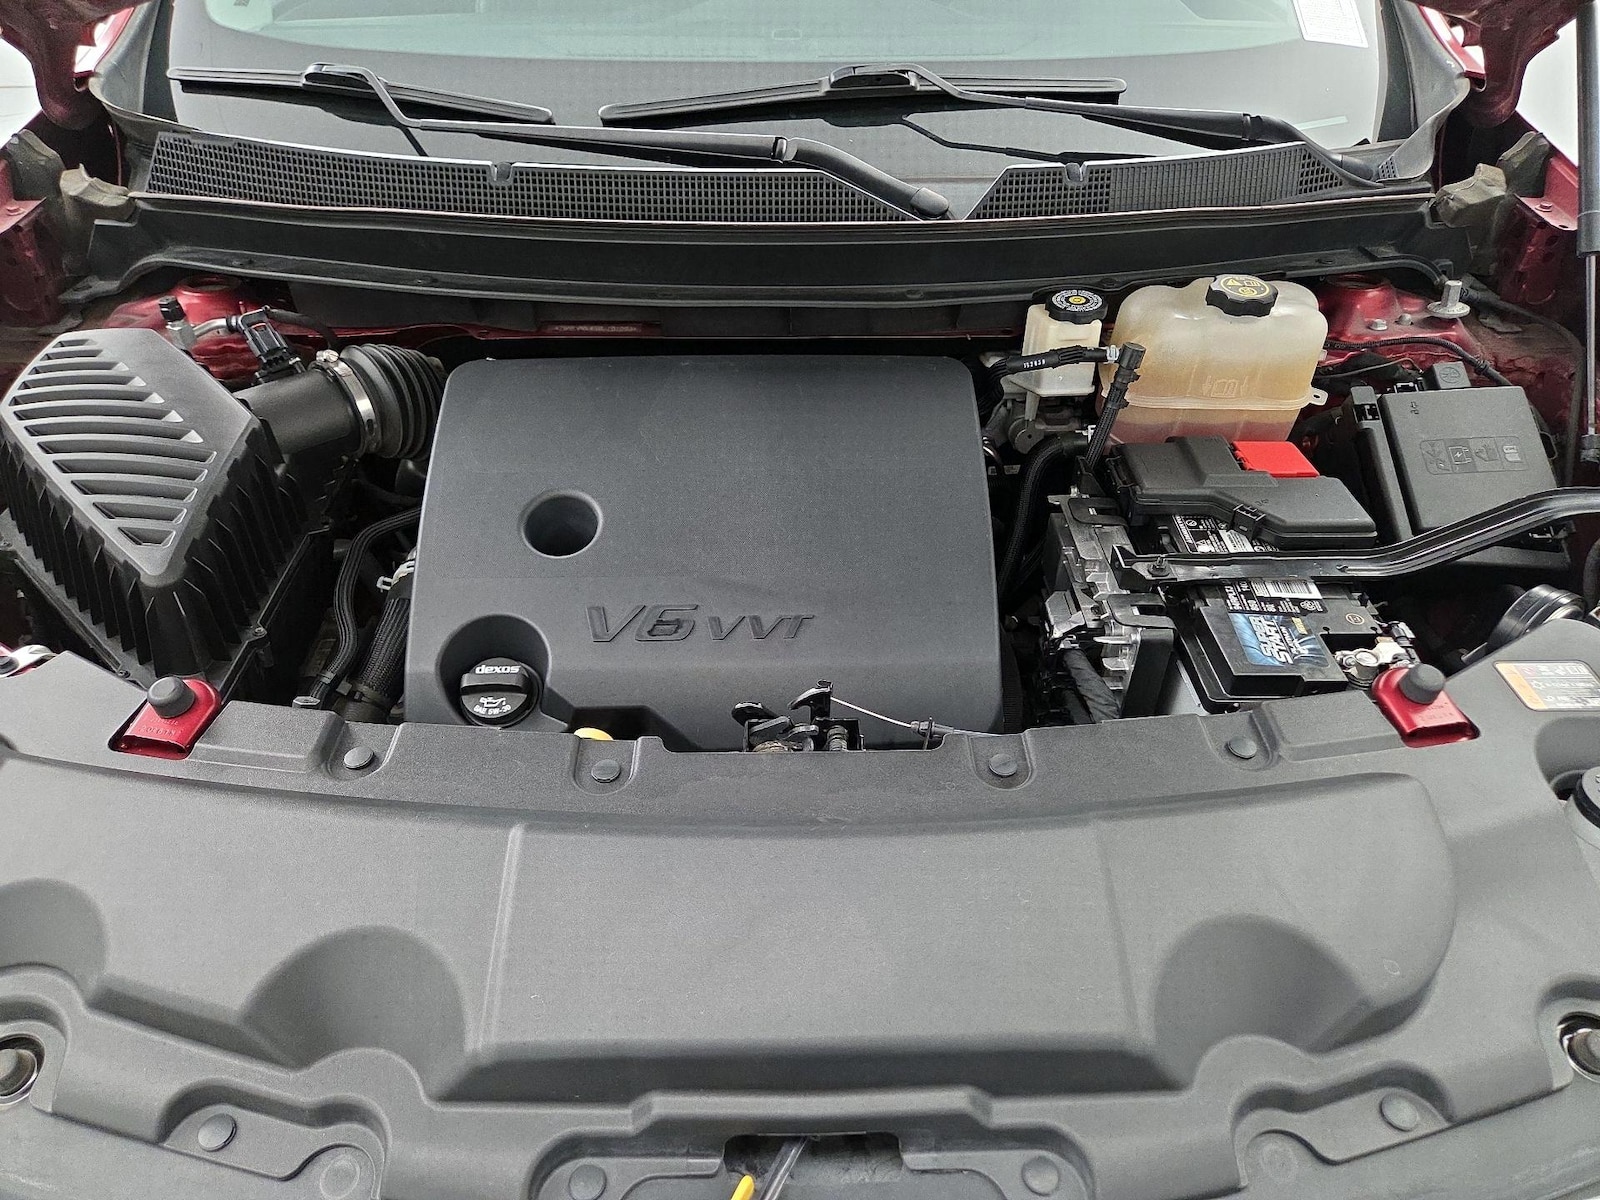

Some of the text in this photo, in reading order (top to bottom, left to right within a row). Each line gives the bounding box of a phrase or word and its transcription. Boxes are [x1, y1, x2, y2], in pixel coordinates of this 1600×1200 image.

[585, 604, 815, 643] V6 VVT
[1249, 616, 1273, 657] SUPER
[1261, 617, 1294, 664] START
[475, 664, 521, 675] dexos
